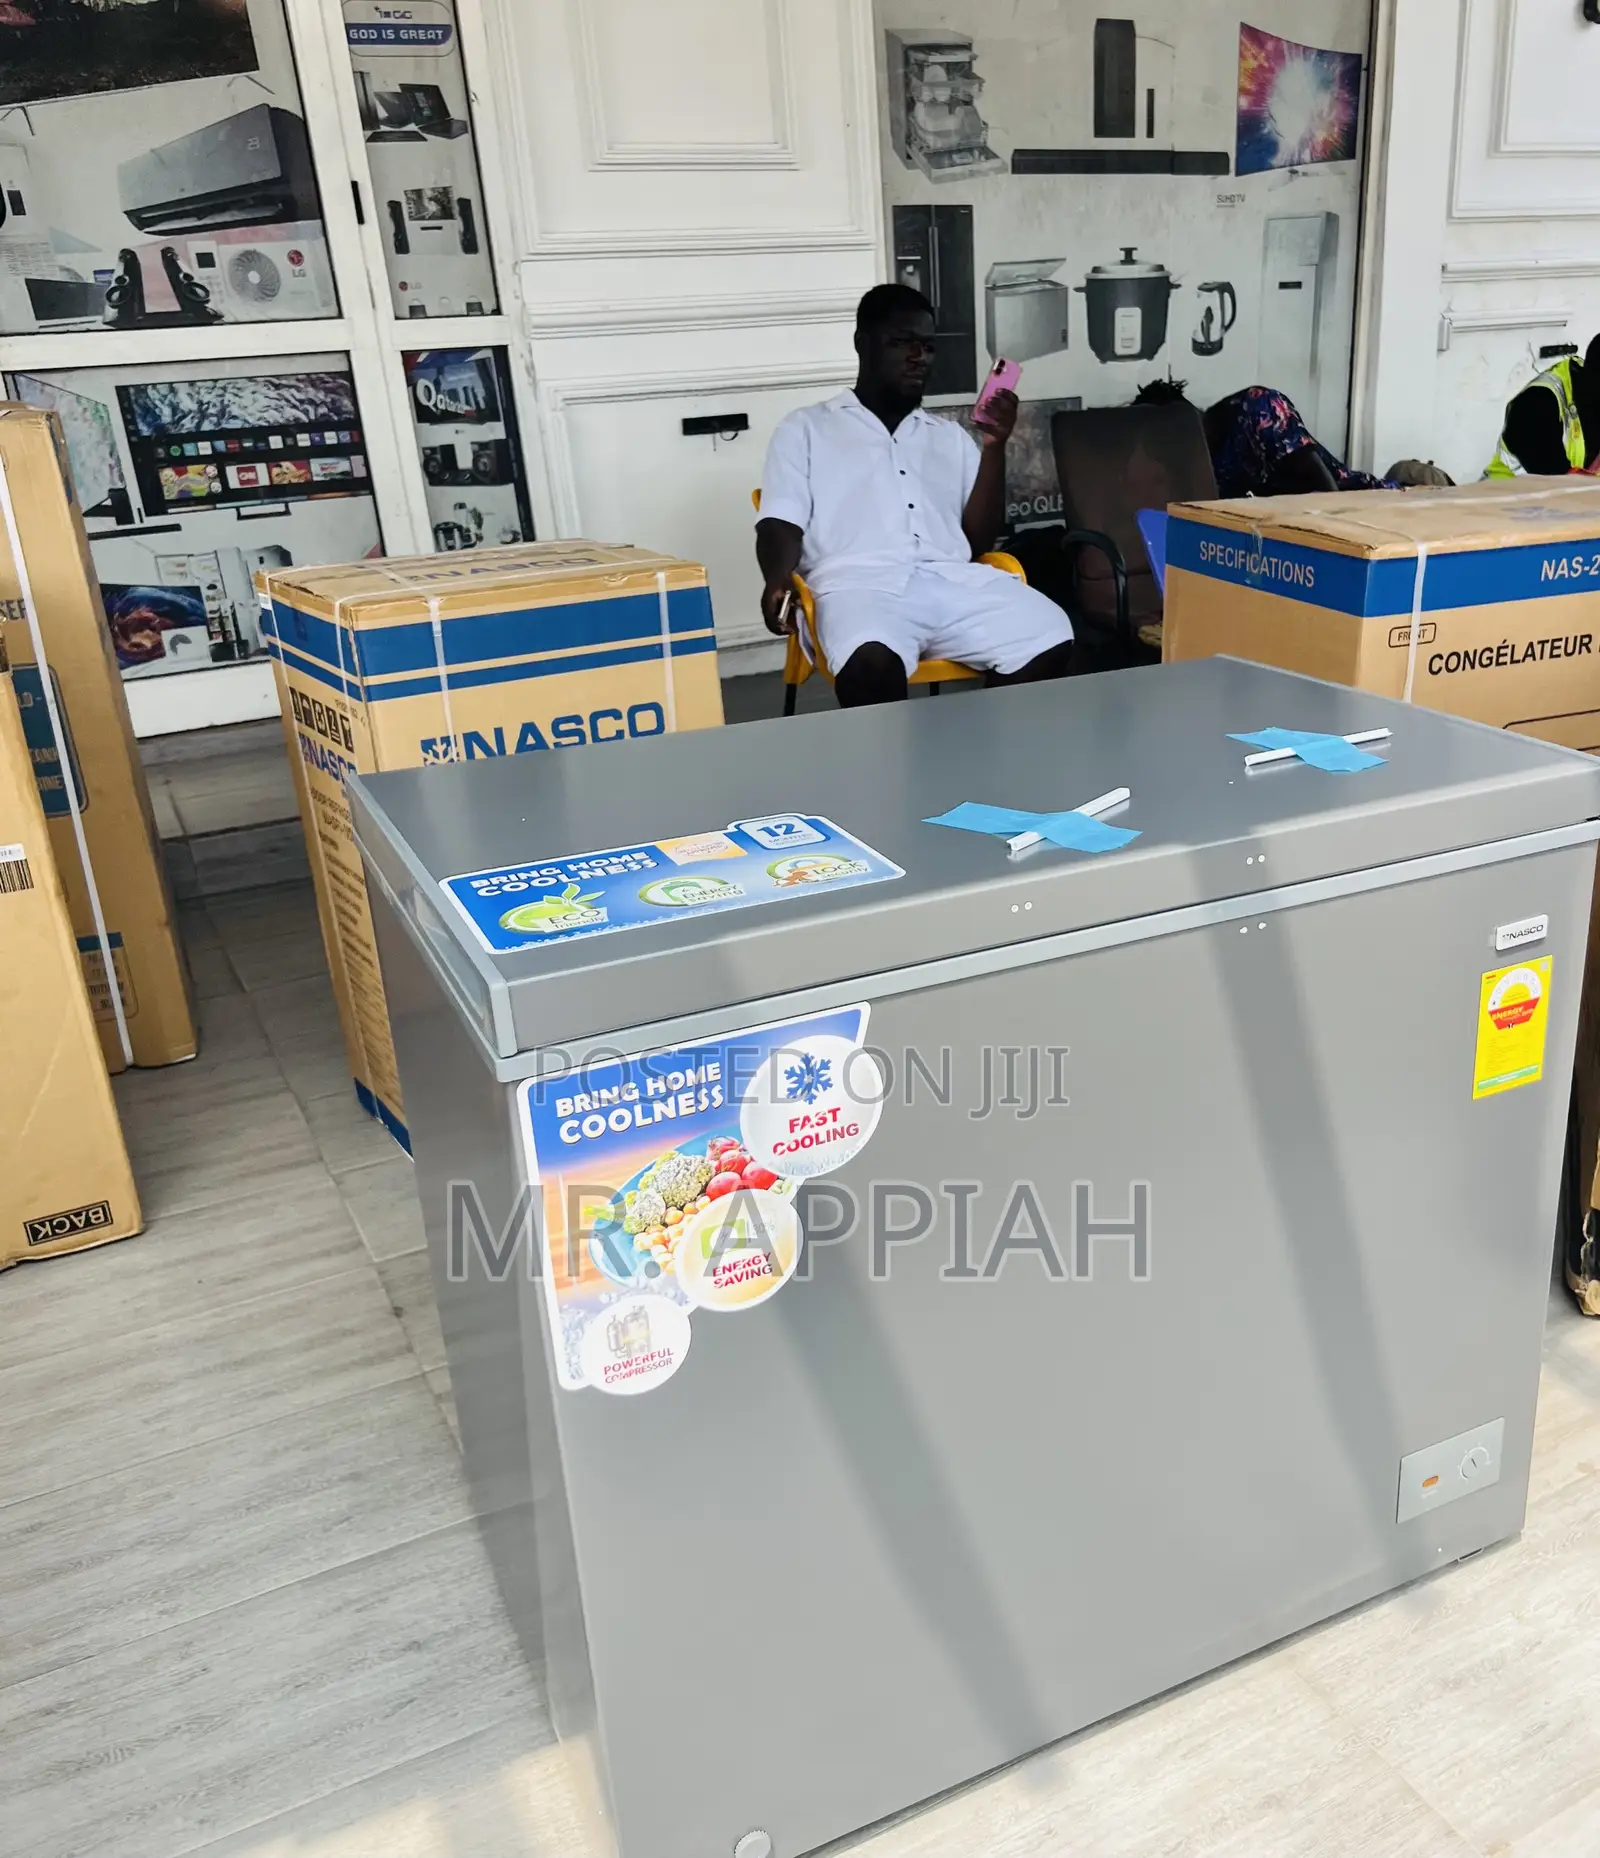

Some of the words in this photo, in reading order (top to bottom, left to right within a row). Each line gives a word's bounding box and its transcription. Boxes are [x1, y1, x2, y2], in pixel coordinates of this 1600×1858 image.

[349, 28, 378, 40] GOD
[382, 29, 396, 40] IS
[399, 29, 444, 40] GREAT
[291, 268, 306, 279] LG
[1199, 540, 1316, 589] SPECIFICATIONS
[1427, 633, 1593, 676] CONGÉLATEUR
[461, 701, 666, 762] NASCO
[756, 823, 802, 837] 12
[469, 867, 562, 889] BRING
[566, 851, 650, 872] HOME
[477, 860, 659, 897] COOLNESS
[812, 861, 859, 875] LOCK
[548, 909, 601, 924] ECO
[1508, 924, 1544, 940] NASCO
[555, 1082, 640, 1118] BRING
[645, 1062, 722, 1096] HOME
[559, 1085, 724, 1145] COOLNESS
[788, 1107, 842, 1134] FAST
[772, 1123, 860, 1156] COOLING
[32, 1206, 105, 1240] BACK
[712, 1251, 772, 1278] ENERGY
[713, 1263, 773, 1290] SAVING
[603, 1347, 675, 1376] POWERFUL
[604, 1357, 673, 1384] COMPRESSOR
